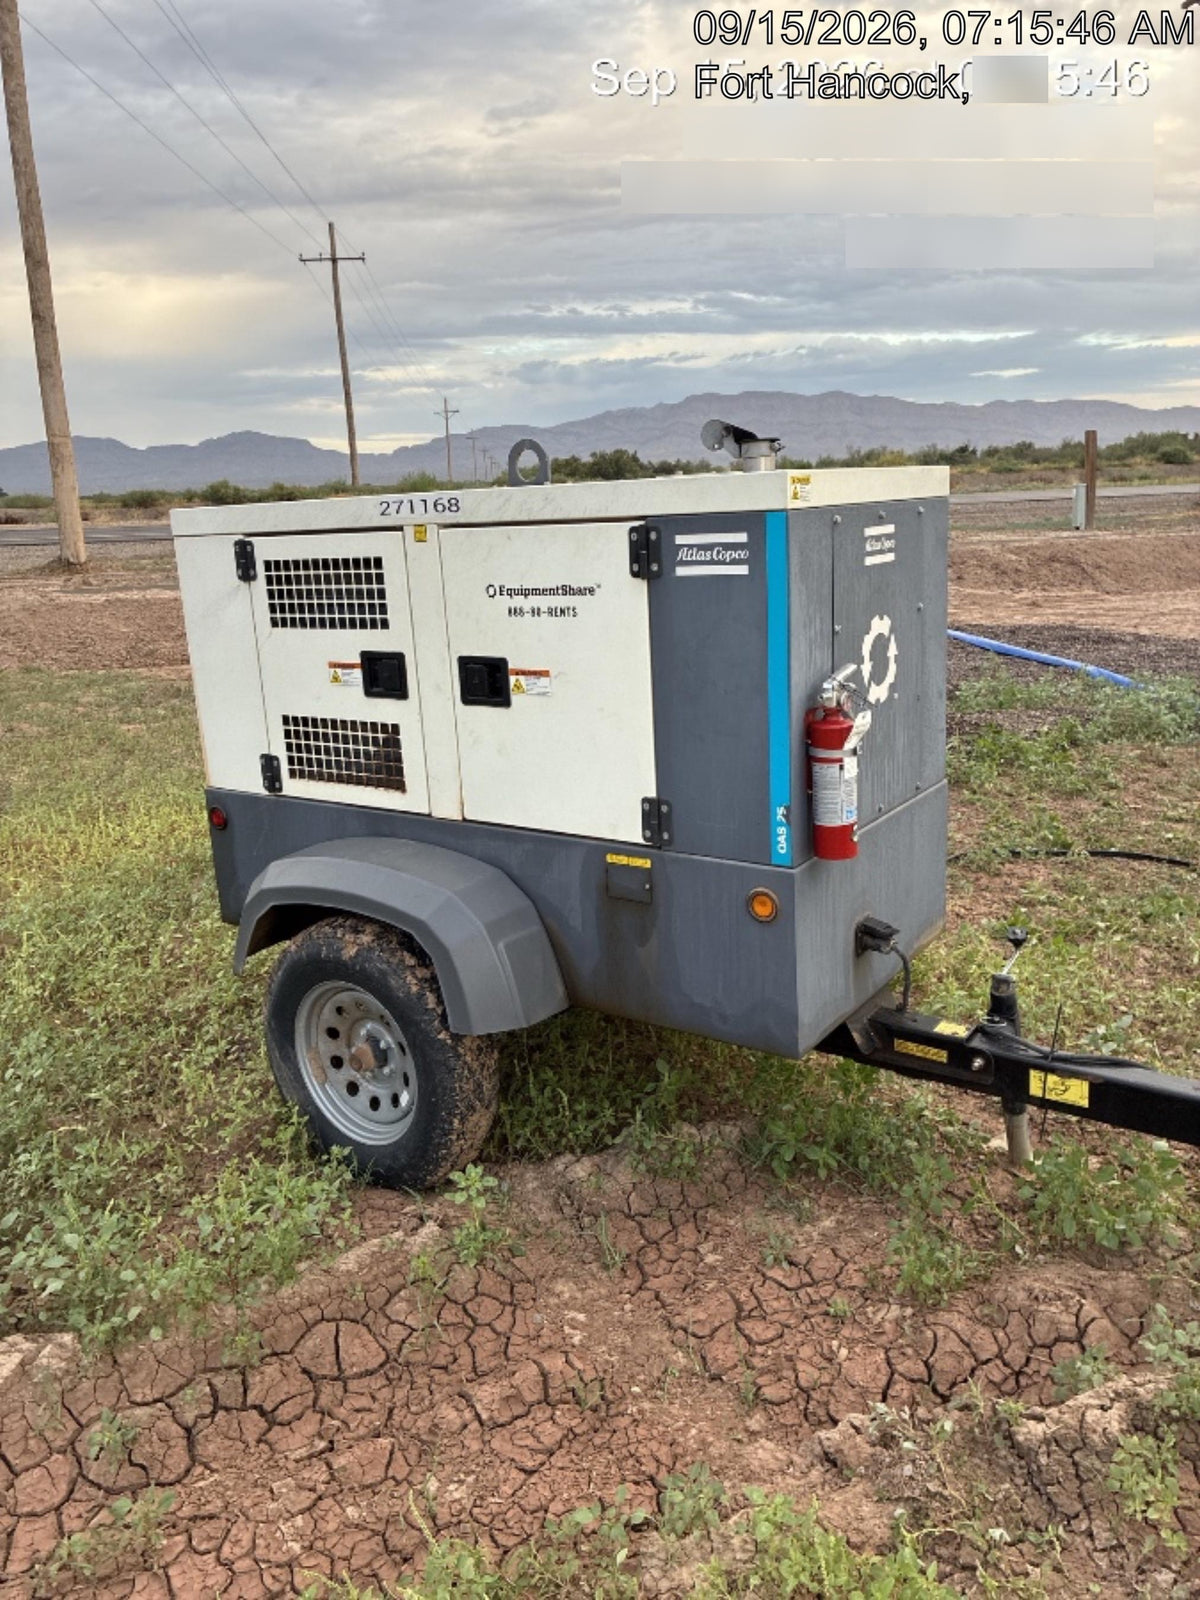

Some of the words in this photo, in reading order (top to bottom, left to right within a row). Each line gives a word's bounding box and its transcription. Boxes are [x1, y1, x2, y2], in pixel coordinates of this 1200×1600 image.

[379, 497, 460, 516] 271168
[676, 546, 712, 562] Atlas
[712, 546, 749, 563] Copco
